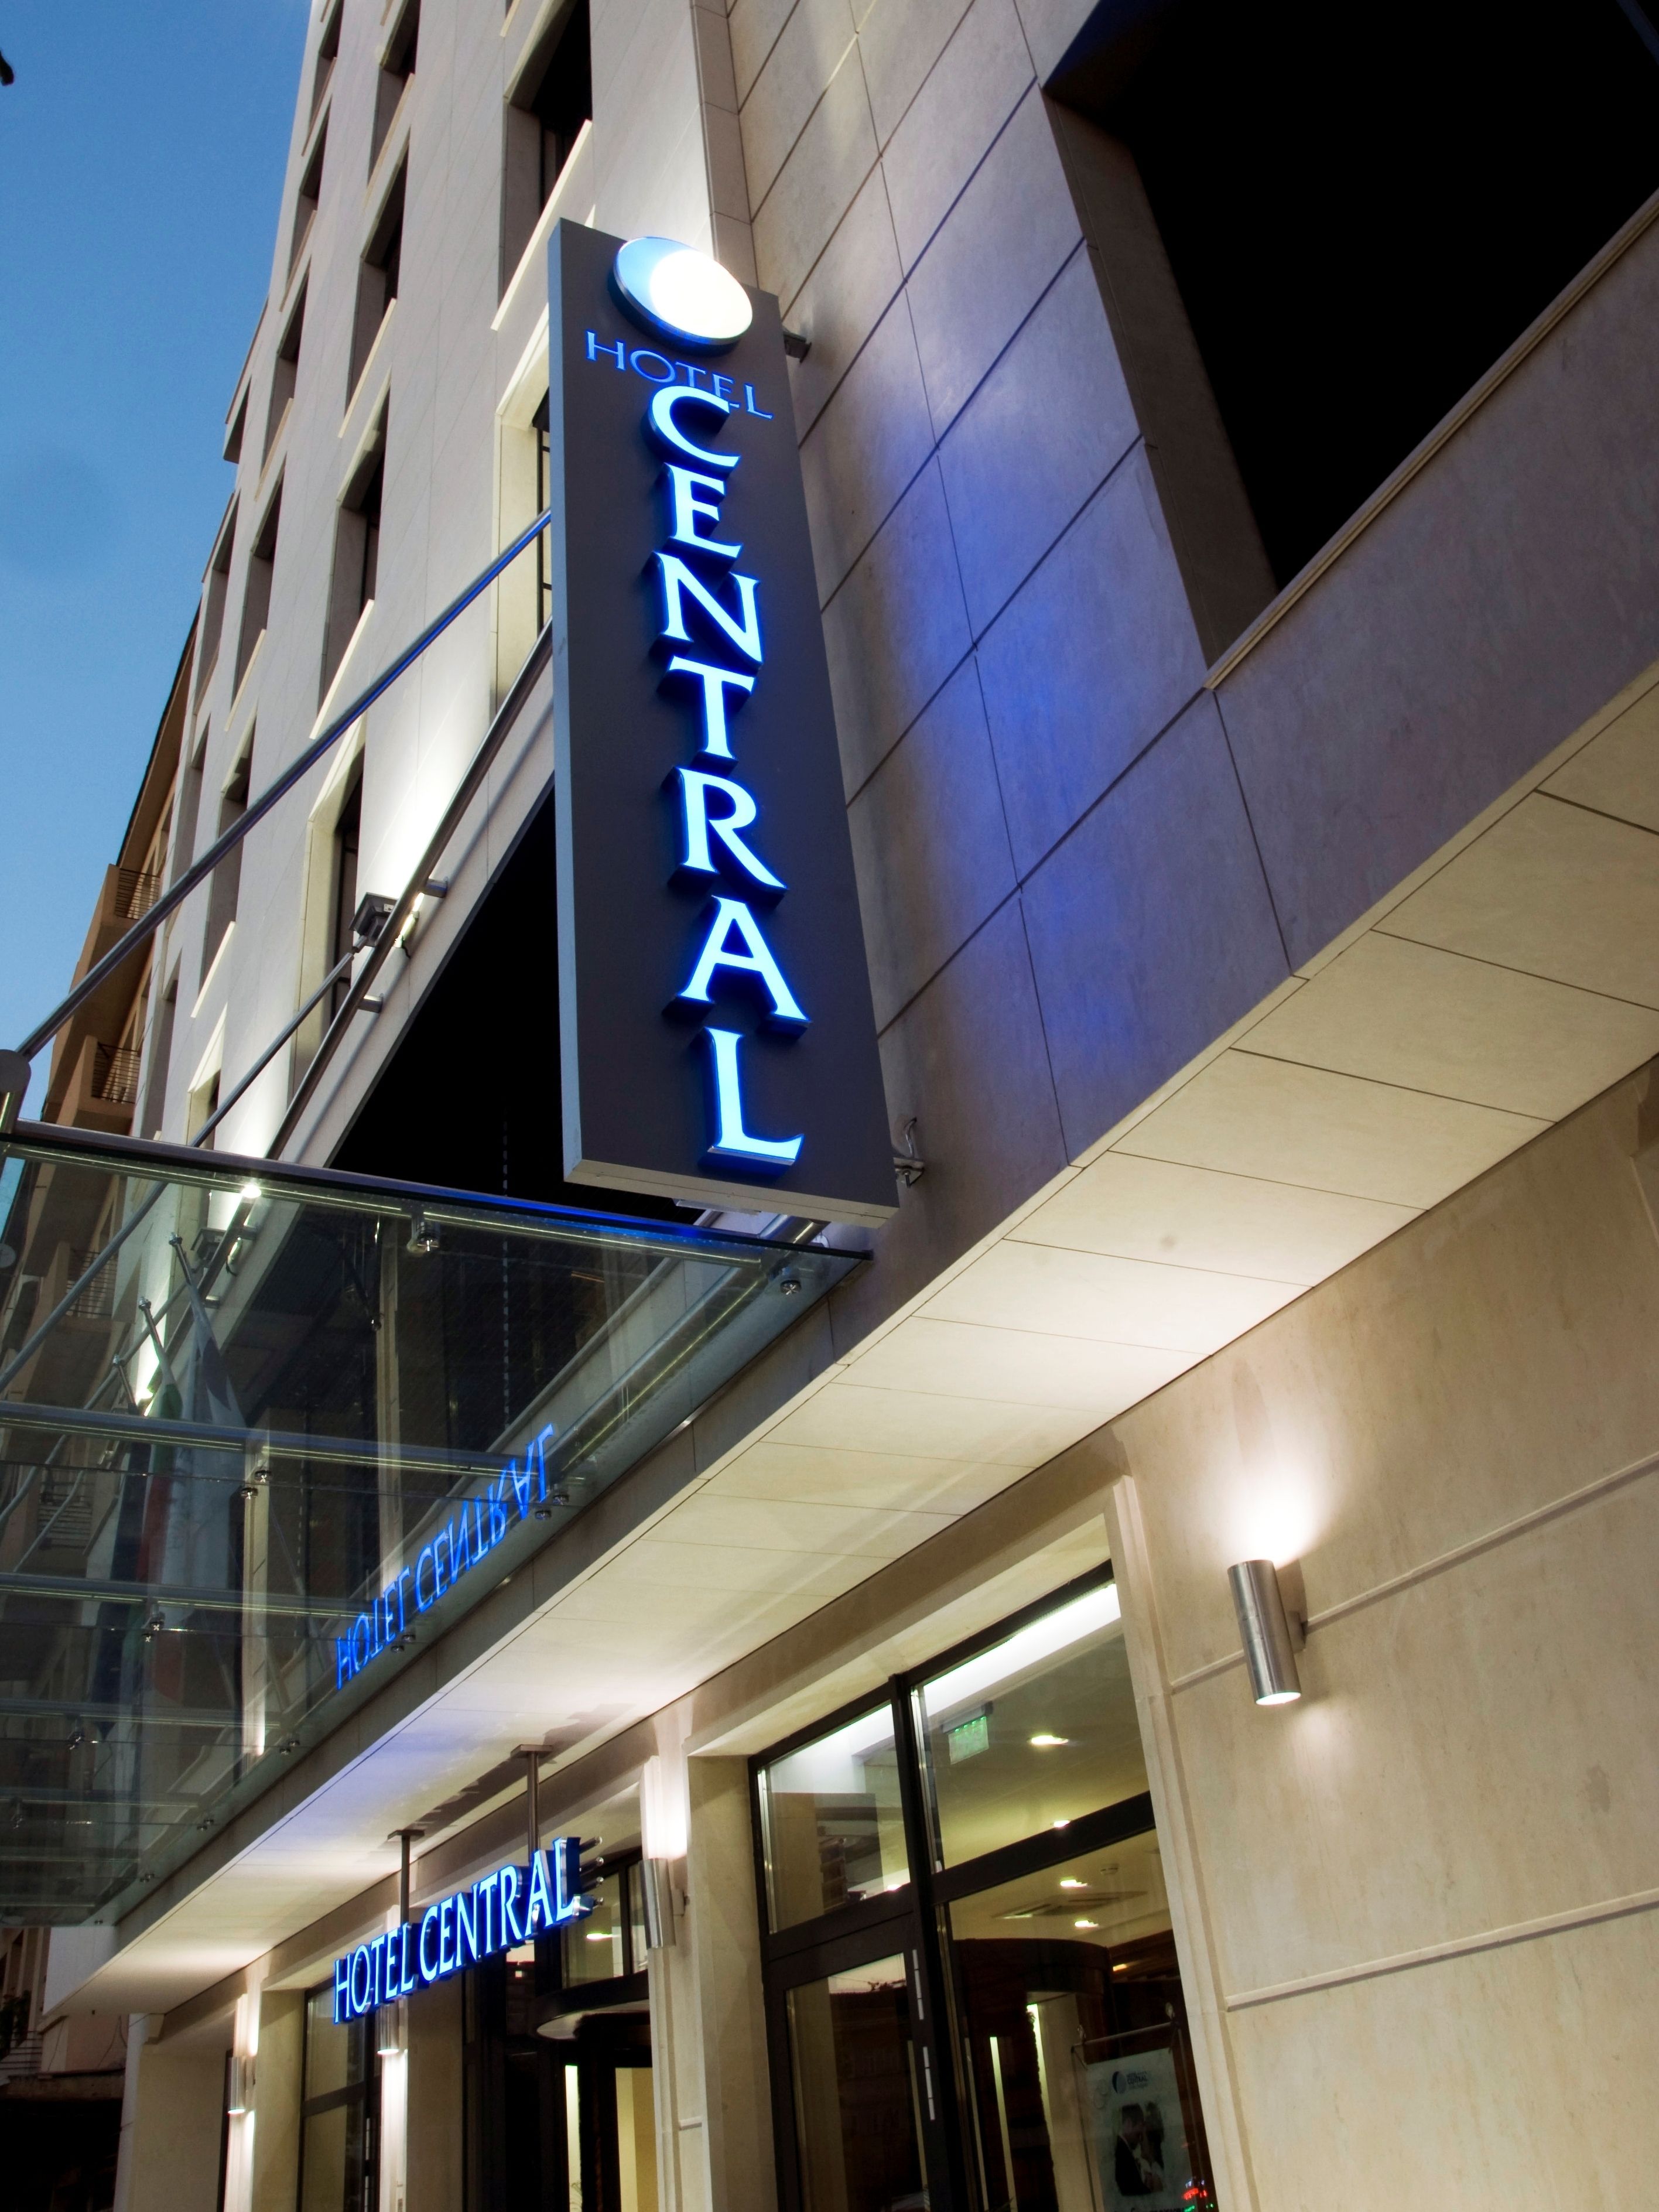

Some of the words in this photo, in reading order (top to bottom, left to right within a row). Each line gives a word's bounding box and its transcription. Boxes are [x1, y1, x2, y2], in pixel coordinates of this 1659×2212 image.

[586, 330, 774, 420] HOTEL
[648, 384, 812, 1164] CENTRAL
[333, 1922, 416, 2024] HOTEL
[419, 1837, 586, 1983] CENTRAL
